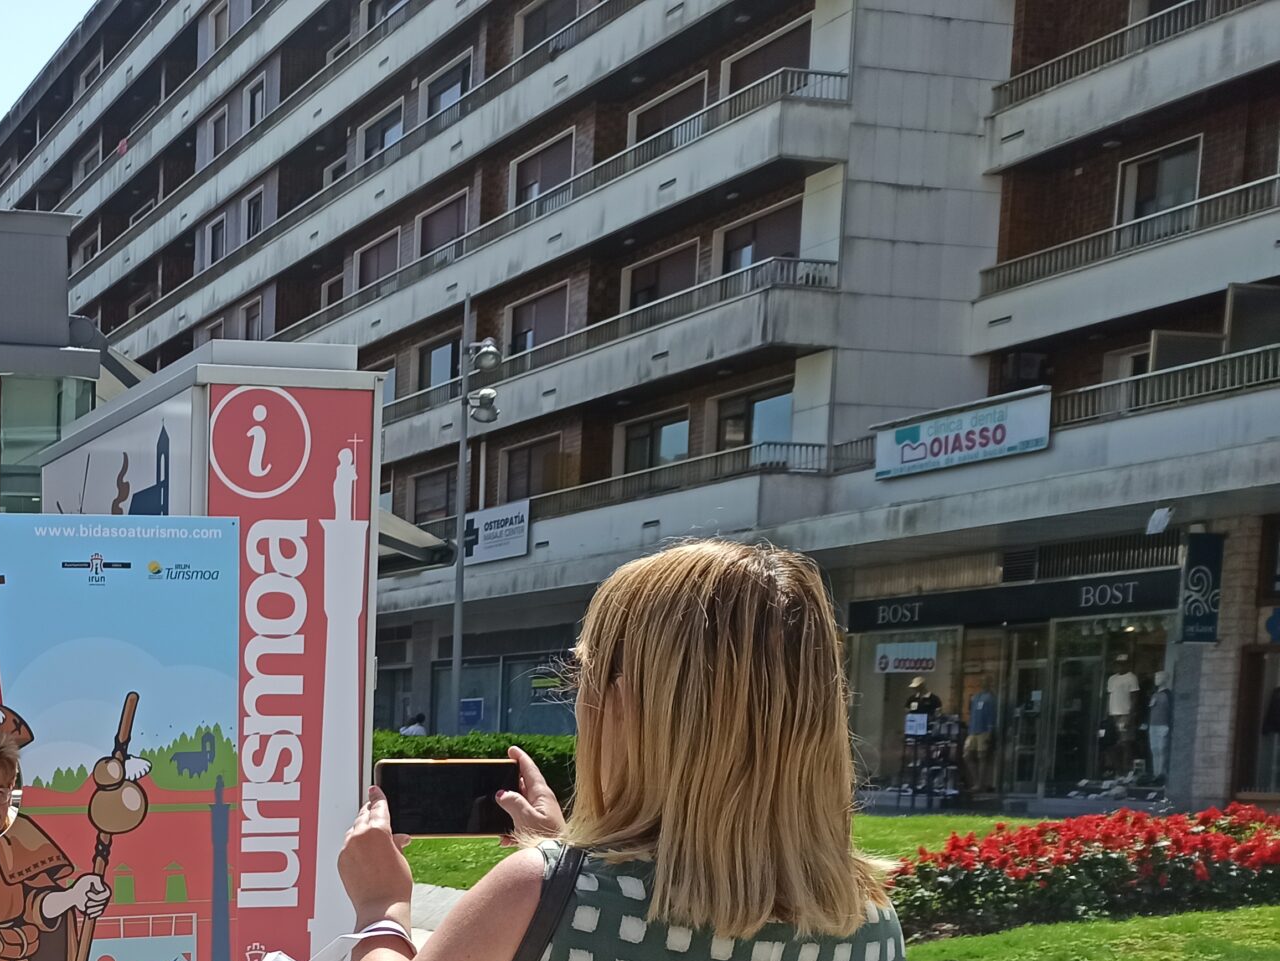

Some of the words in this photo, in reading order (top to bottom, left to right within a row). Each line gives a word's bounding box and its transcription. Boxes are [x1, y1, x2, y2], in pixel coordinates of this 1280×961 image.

[970, 406, 1008, 427] dental
[929, 423, 1007, 458] OIASSO
[34, 523, 222, 541] www.bidasoaturismo.com
[483, 511, 525, 532] OSTEOPATÍA
[165, 568, 220, 581] Turismoa
[877, 602, 923, 624] BOST
[1080, 581, 1139, 607] BOST
